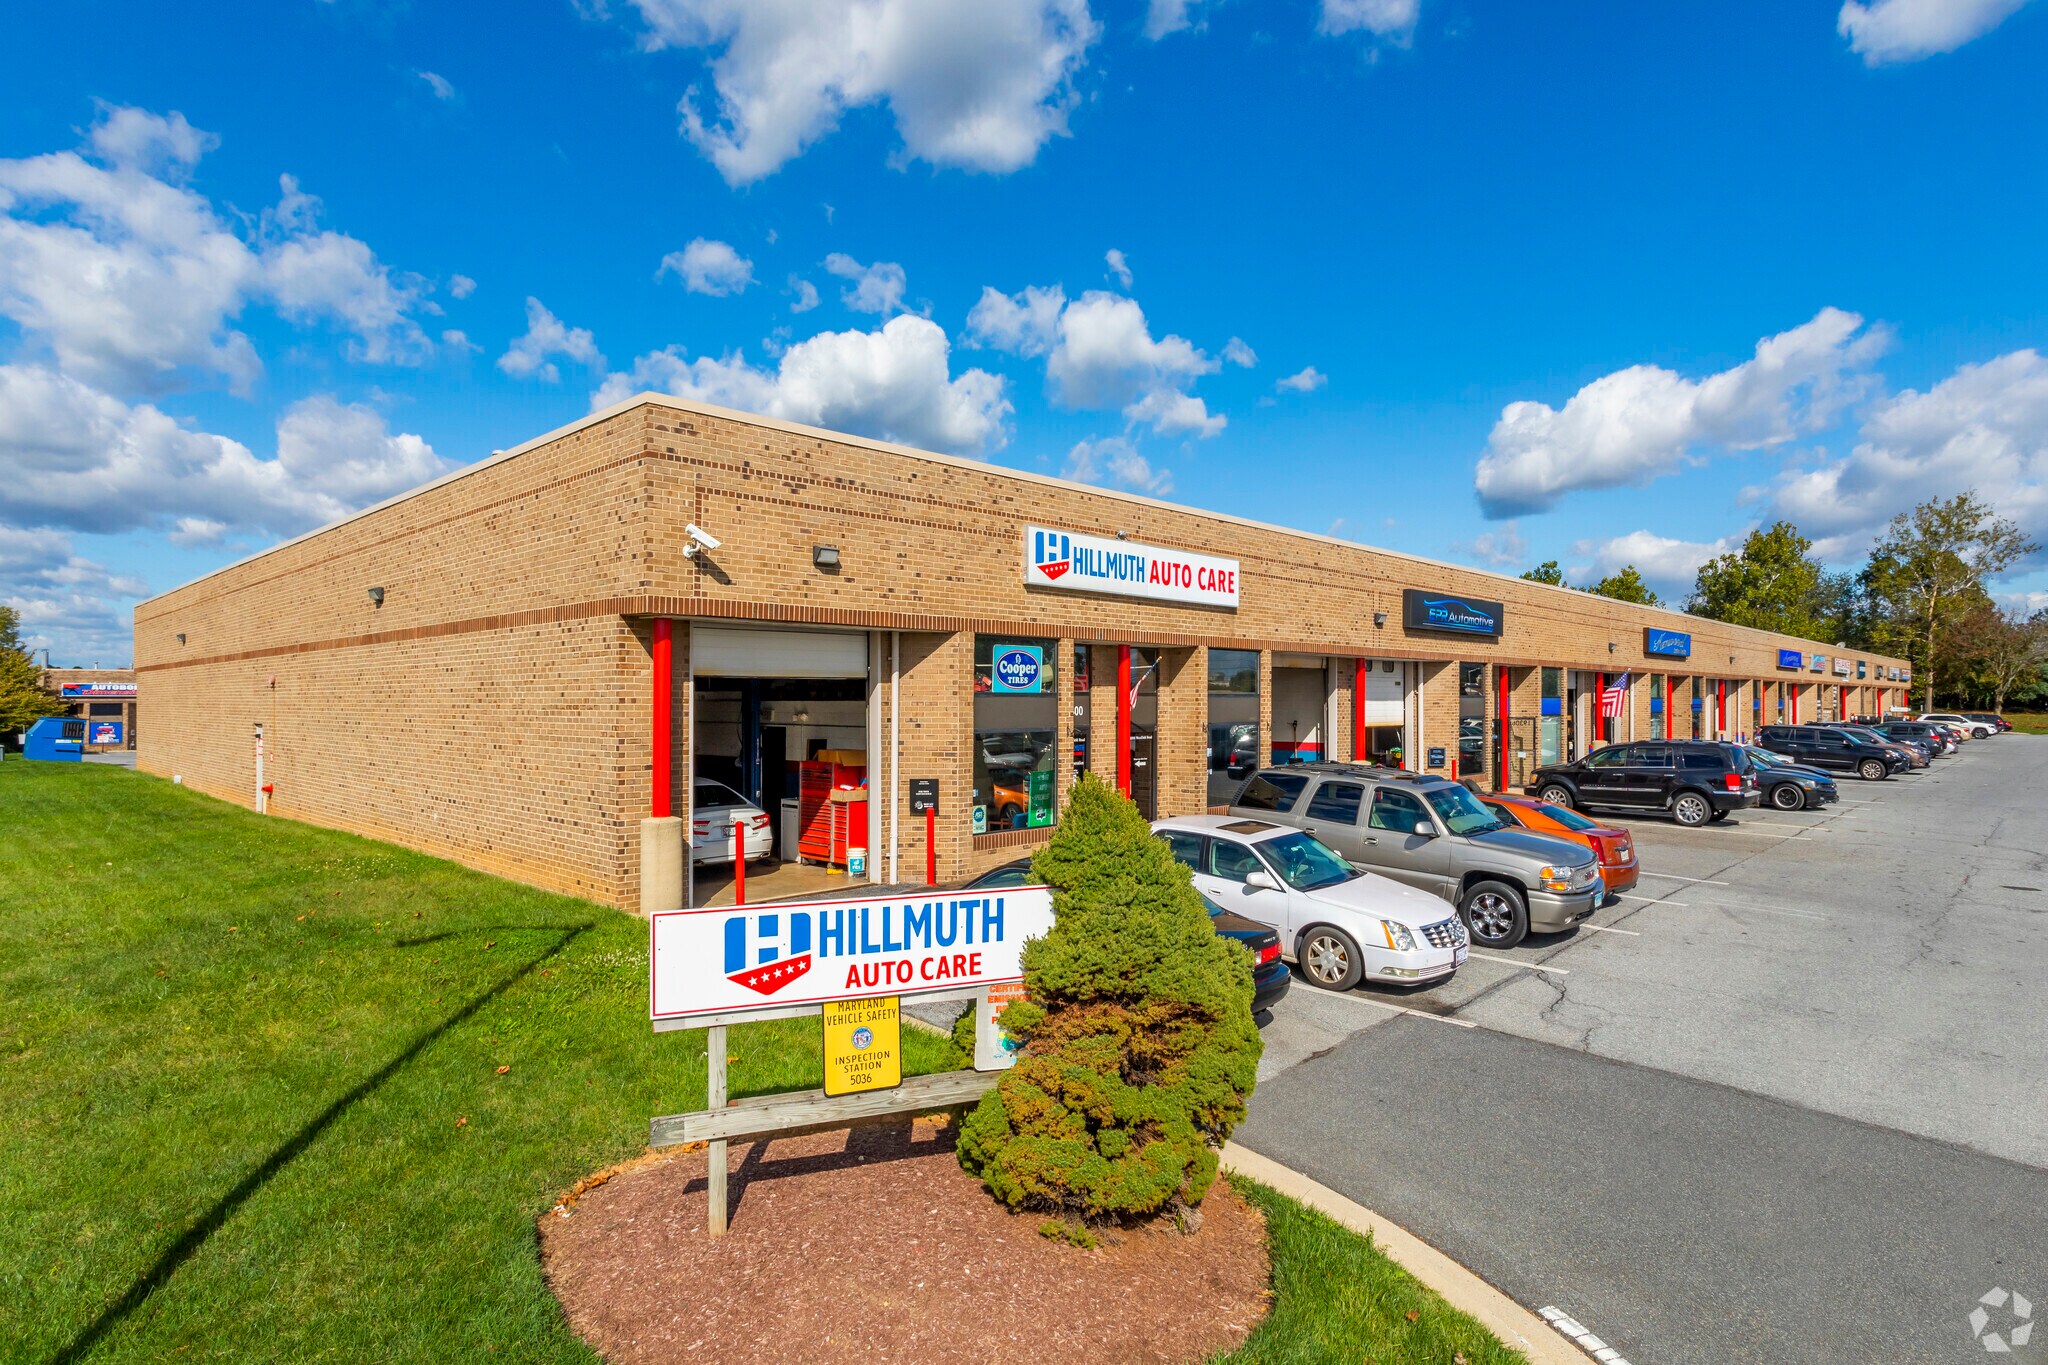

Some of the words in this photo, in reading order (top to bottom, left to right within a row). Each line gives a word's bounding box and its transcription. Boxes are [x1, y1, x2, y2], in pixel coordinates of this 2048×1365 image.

[1073, 547, 1145, 583] HILLMUTH
[1149, 559, 1192, 589] AUTO
[1198, 566, 1235, 594] CARE
[1429, 608, 1448, 621] EPR
[1448, 611, 1494, 627] Automotive
[999, 660, 1037, 677] Cooper
[1008, 676, 1029, 684] TIRES
[820, 897, 1004, 958] HILLMUTH
[845, 959, 913, 989] AUTO
[921, 952, 982, 981] CARE
[838, 997, 885, 1012] MARYLAND
[827, 1012, 863, 1026] VEHICLE
[867, 1008, 897, 1022] SAFETY
[835, 1050, 890, 1065] INSPECTION
[844, 1061, 882, 1073] STATION
[850, 1073, 872, 1085] 5036
